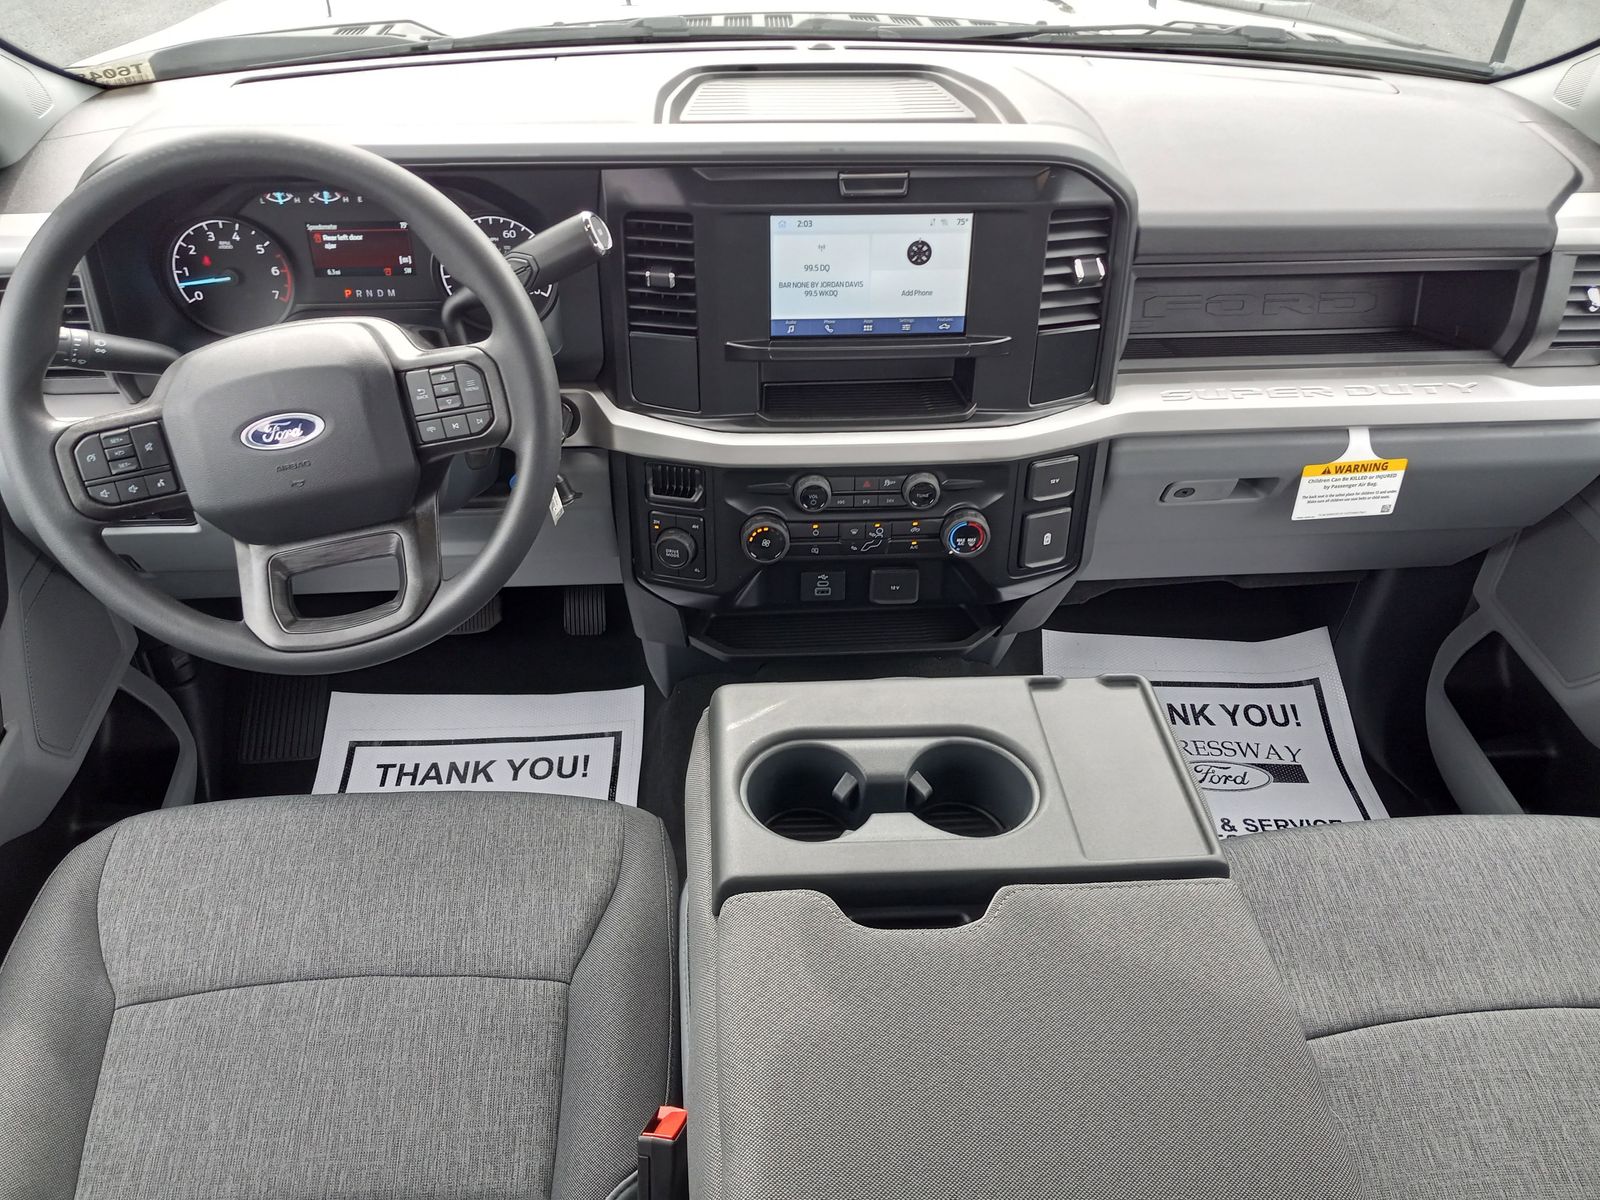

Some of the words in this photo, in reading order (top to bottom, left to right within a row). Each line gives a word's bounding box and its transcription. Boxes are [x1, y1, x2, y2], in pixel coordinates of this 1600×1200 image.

[797, 220, 813, 228] 2:03
[206, 232, 215, 241] 3
[232, 232, 240, 241] 4
[502, 230, 516, 238] 60
[188, 245, 197, 254] 2
[256, 244, 265, 254] 5
[183, 267, 189, 276] 1
[271, 267, 280, 276] 6
[194, 291, 204, 300] 0
[272, 290, 280, 299] 7
[345, 289, 352, 298] P
[1142, 292, 1378, 318] FORD
[1160, 386, 1335, 402] SUPER
[1344, 382, 1478, 397] DUTY
[262, 421, 304, 442] Ford
[276, 460, 311, 472] AIRBAG
[1334, 462, 1388, 474] WARNING
[1166, 703, 1216, 726] NK
[1219, 704, 1302, 727] YOU!
[376, 759, 496, 787] THANK
[506, 755, 590, 781] YOU!
[1194, 764, 1250, 786] Ford
[1220, 818, 1238, 832] &
